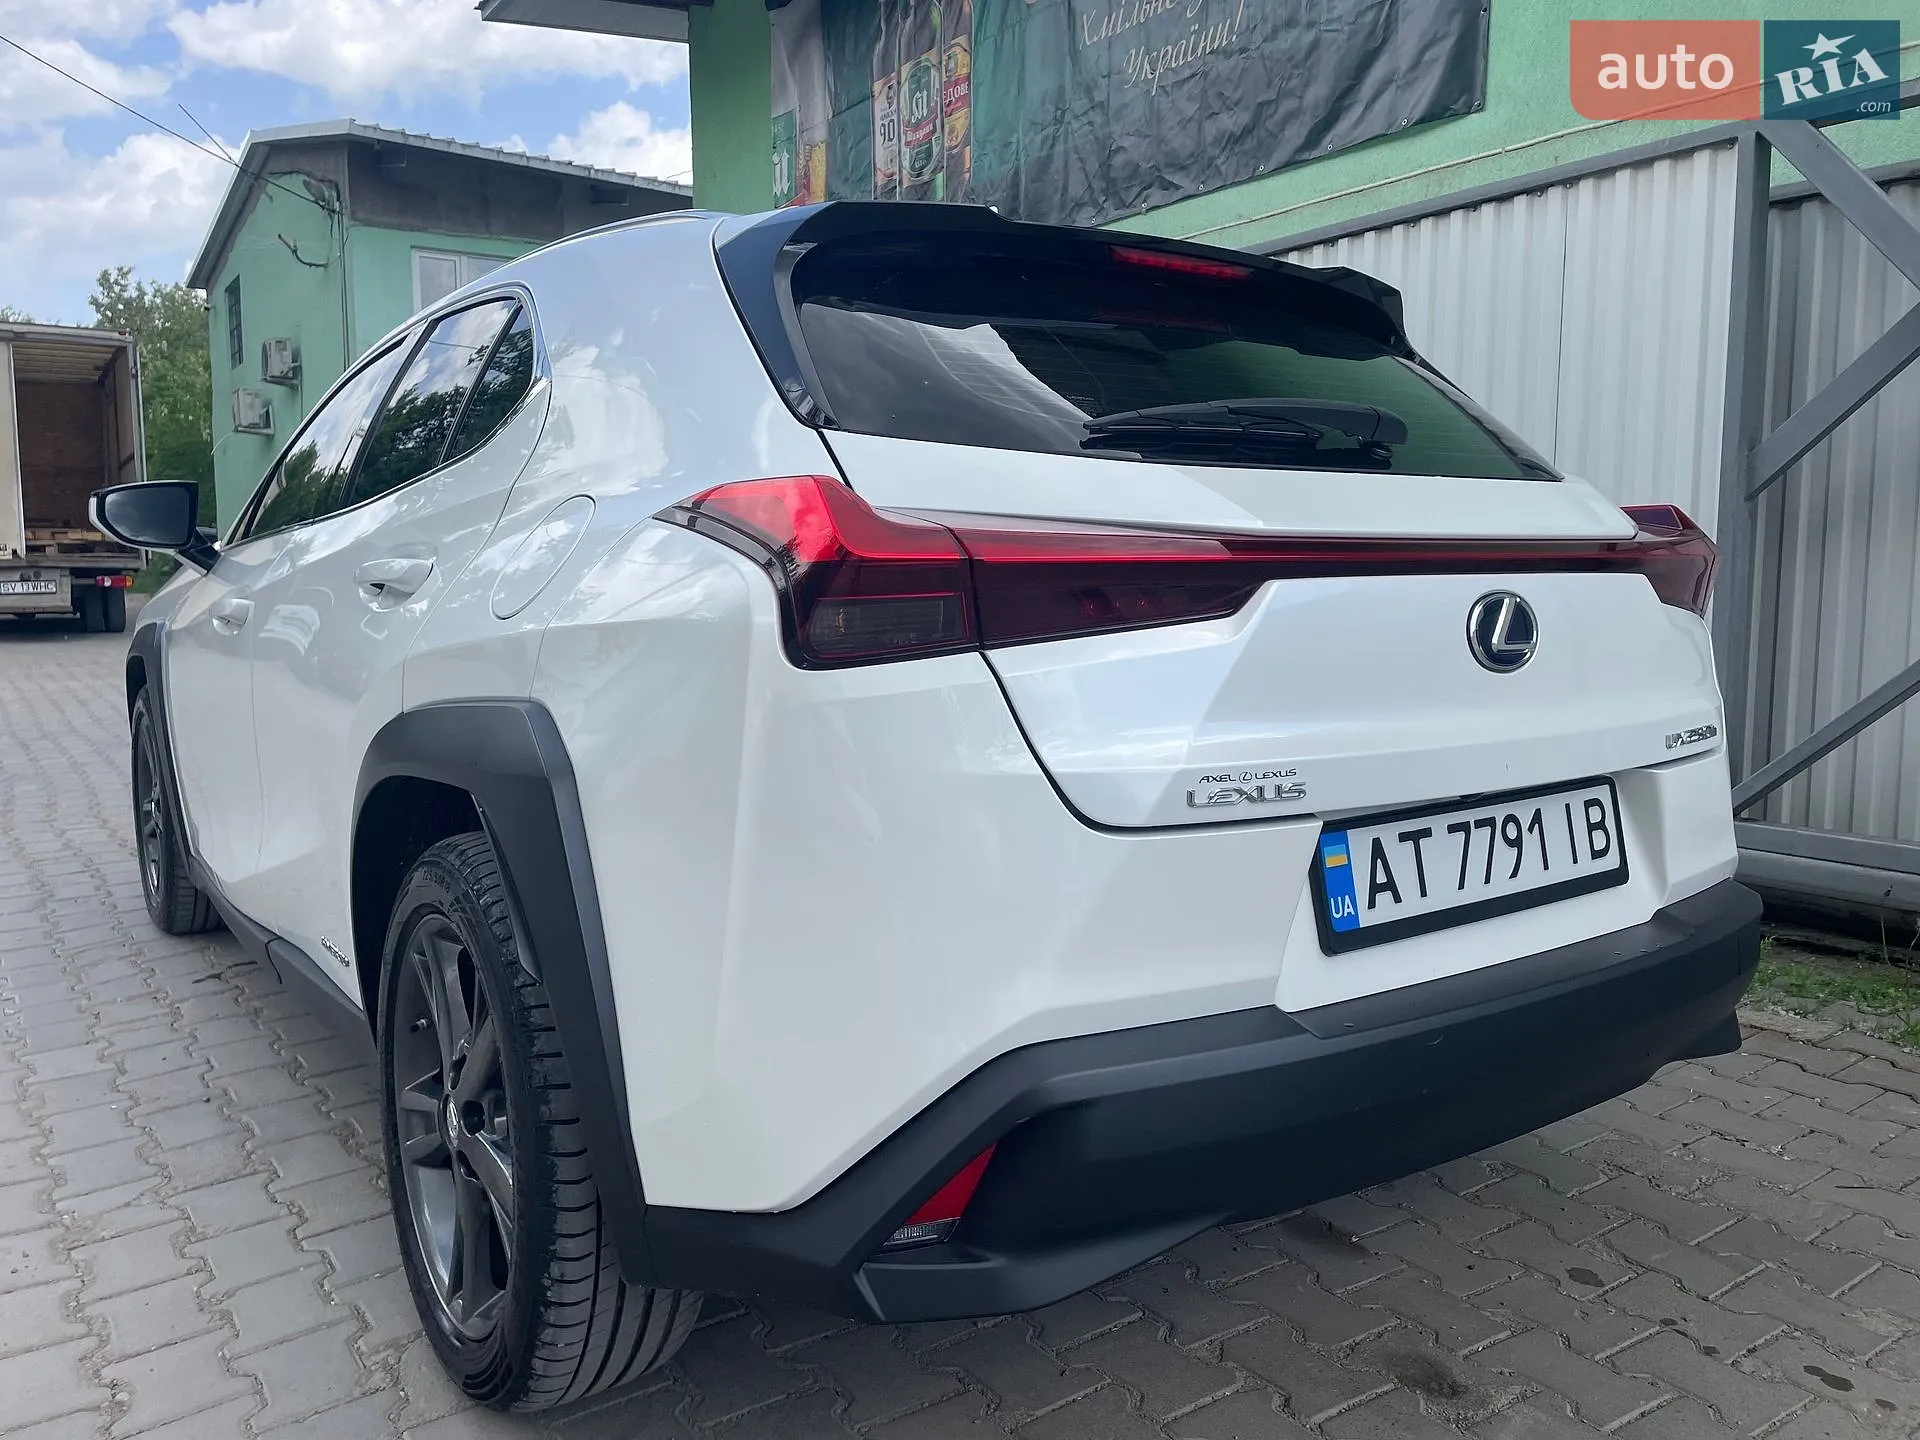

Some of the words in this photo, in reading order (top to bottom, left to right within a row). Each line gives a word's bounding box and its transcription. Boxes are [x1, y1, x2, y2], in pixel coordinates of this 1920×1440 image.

[1124, 0, 1244, 96] України!
[1199, 774, 1237, 784] AXEL
[1255, 768, 1297, 780] LEXUS
[1187, 782, 1307, 808] LEXUS
[1367, 826, 1433, 910] AT
[1447, 807, 1550, 891] 7791
[1565, 797, 1611, 865] IB
[1330, 895, 1355, 919] UA
